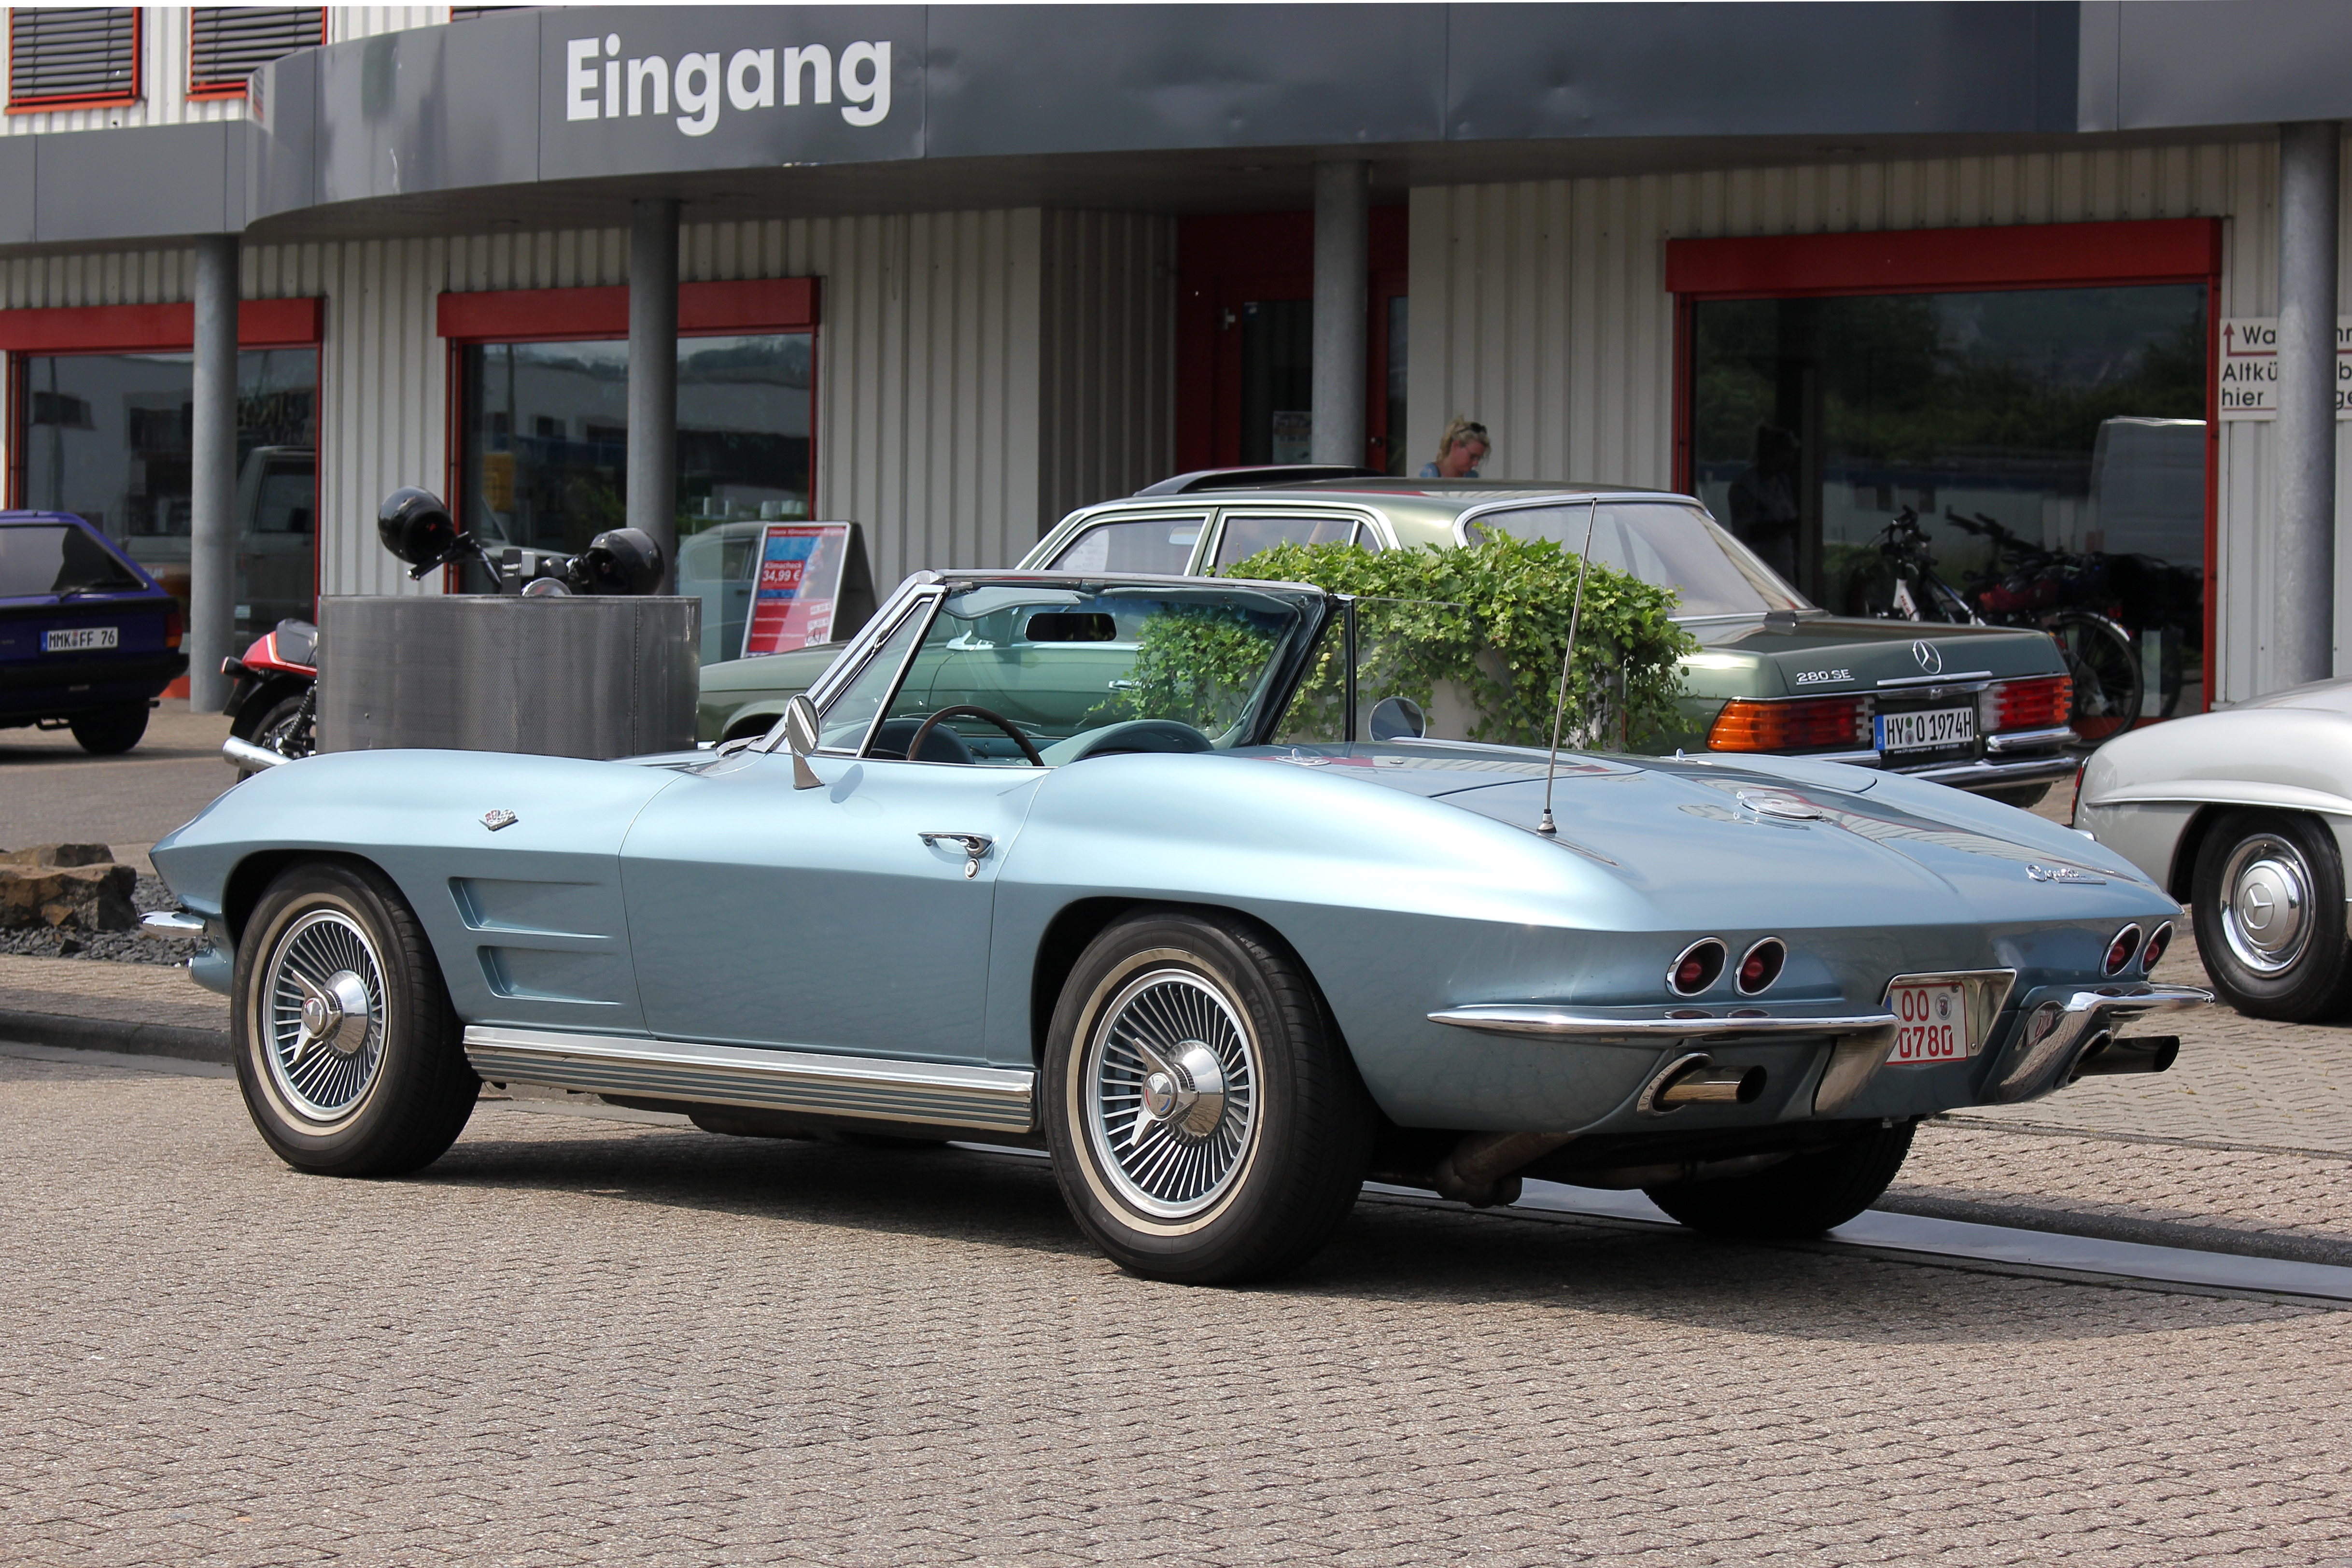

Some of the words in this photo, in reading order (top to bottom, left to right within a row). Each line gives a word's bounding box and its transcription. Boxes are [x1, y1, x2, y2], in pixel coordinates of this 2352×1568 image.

[566, 32, 892, 137] Eingang
[2222, 388, 2264, 406] hier
[762, 569, 791, 583] 34,99
[793, 569, 802, 581] €
[49, 633, 70, 648] MMK
[80, 631, 94, 646] FF
[101, 630, 114, 645] 76
[1796, 671, 1829, 682] 280
[1831, 669, 1851, 679] SE
[1887, 717, 1903, 745] HY
[1929, 711, 1972, 740] 1974H
[1899, 1025, 1953, 1058] 0780
